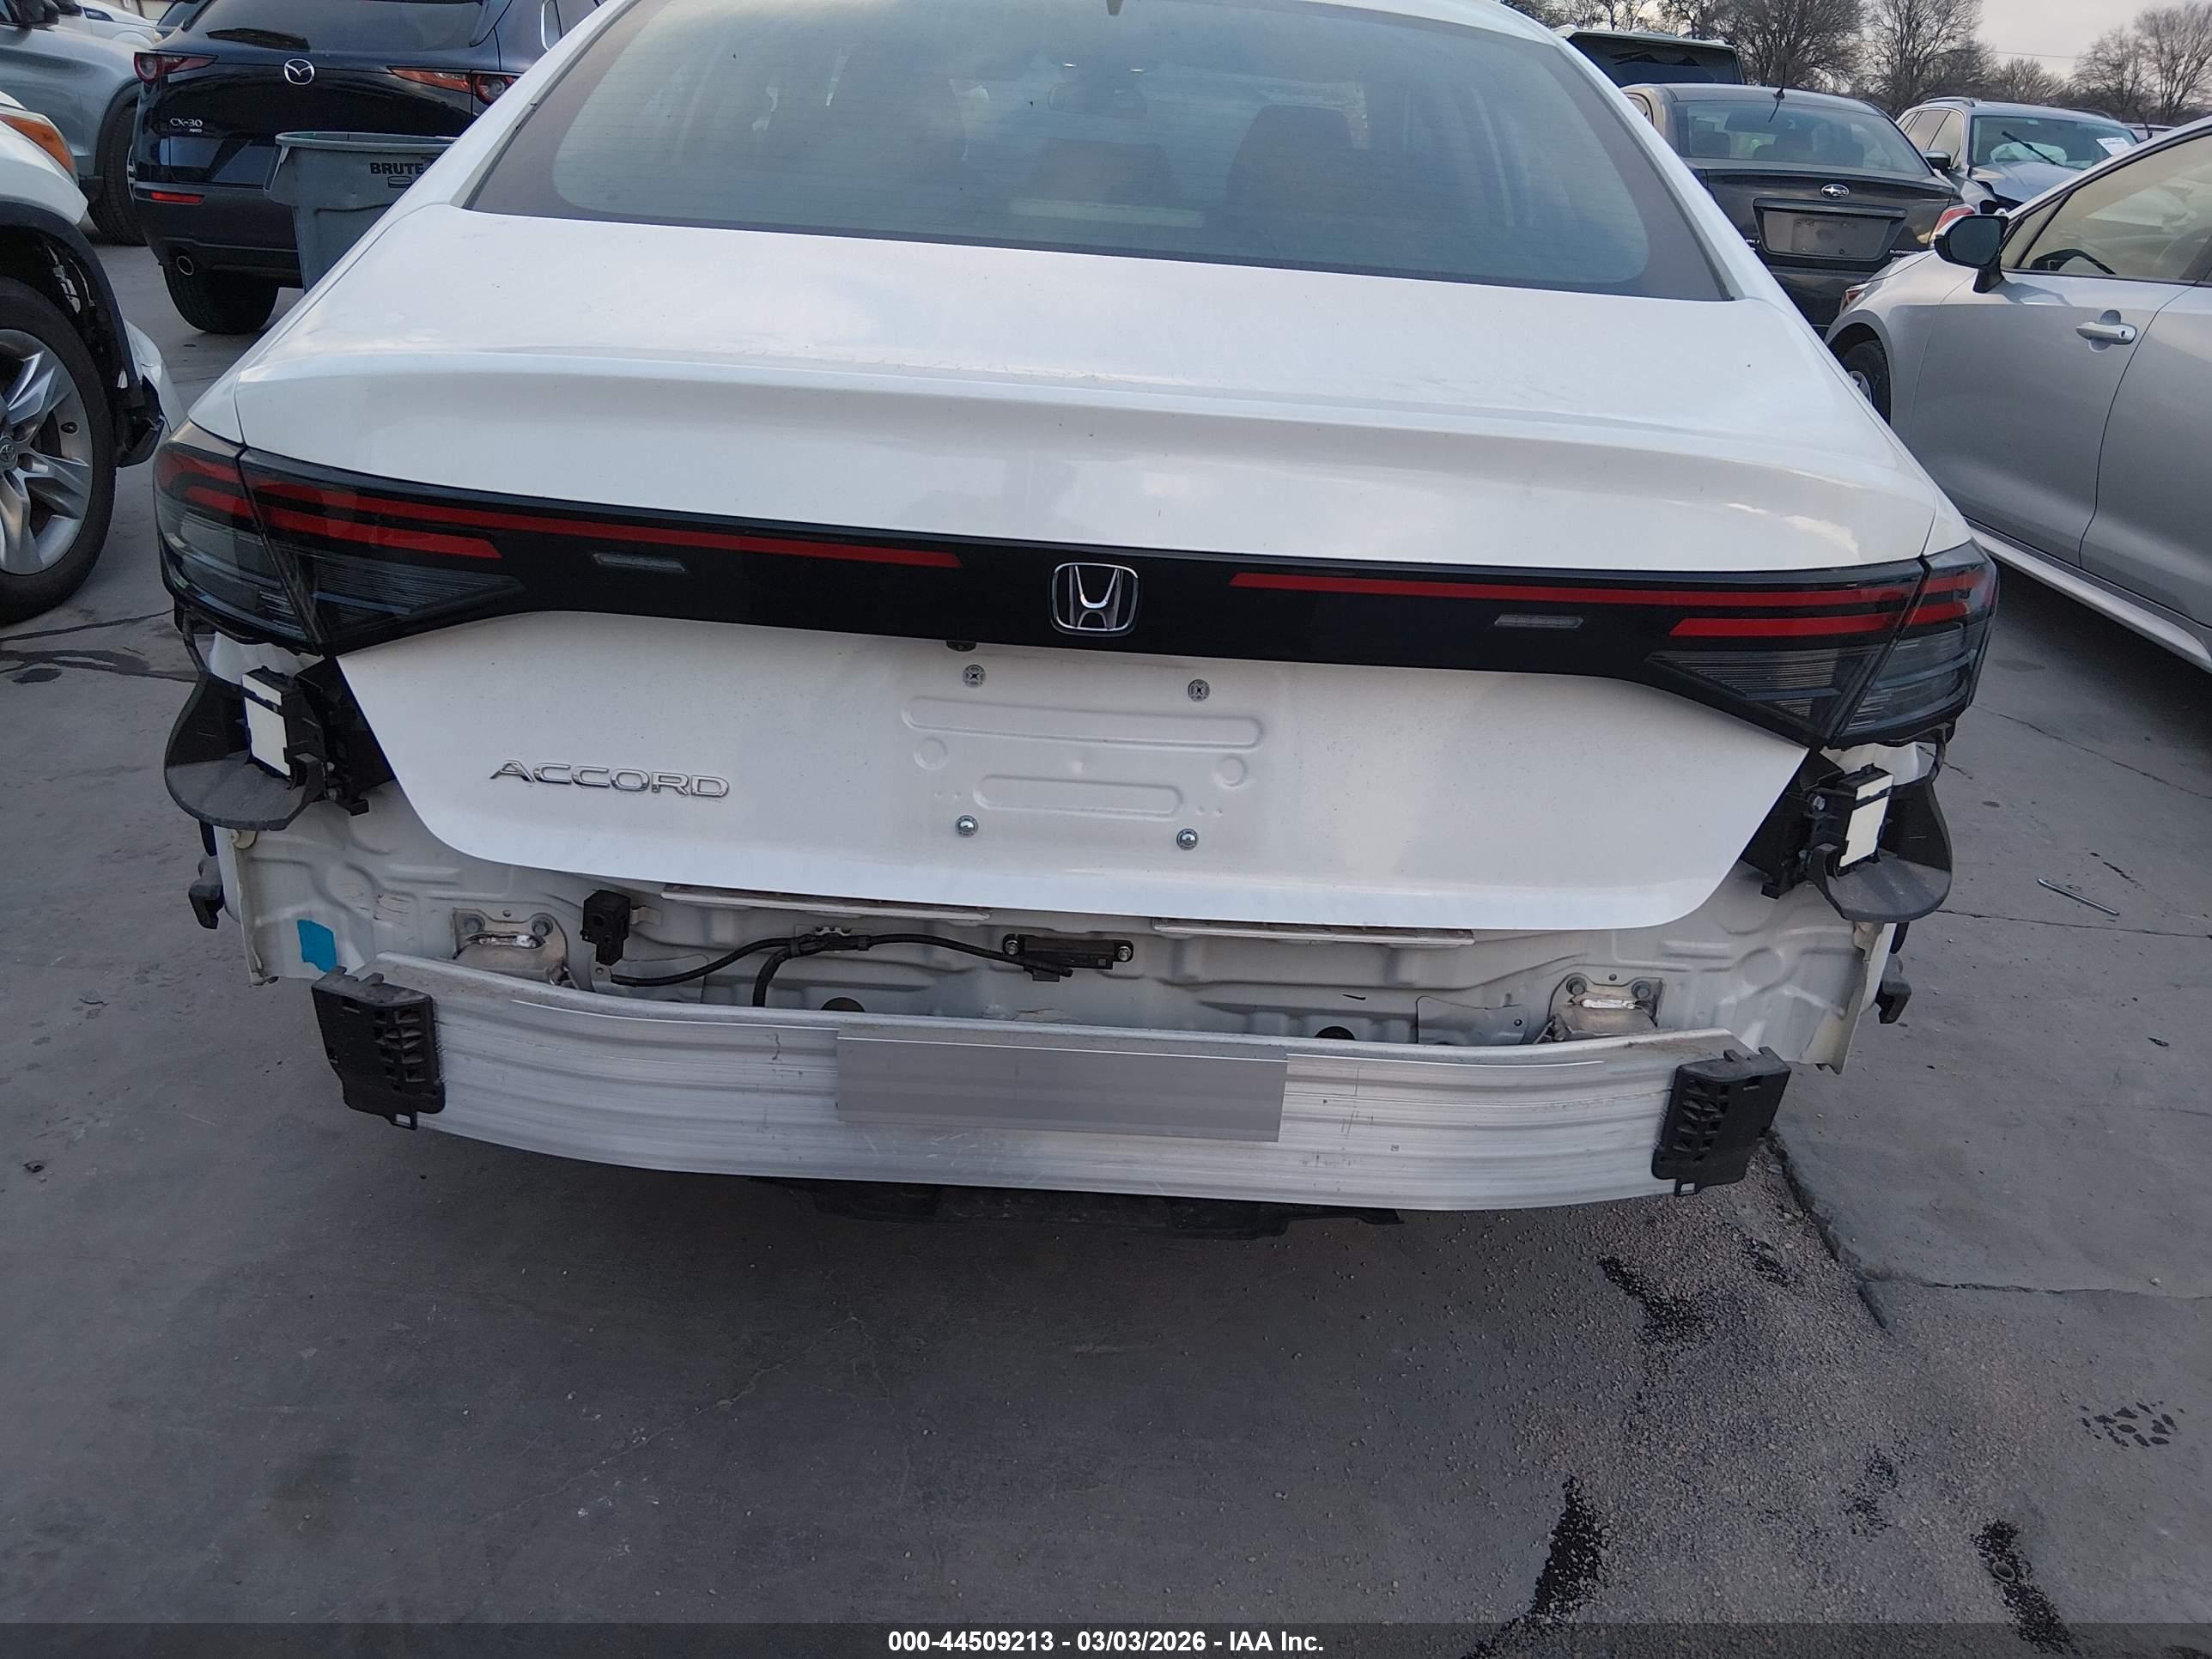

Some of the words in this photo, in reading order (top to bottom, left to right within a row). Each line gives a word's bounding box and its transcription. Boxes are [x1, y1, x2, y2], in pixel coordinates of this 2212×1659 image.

[170, 118, 204, 128] CX-30
[370, 162, 425, 175] BRUTE
[489, 759, 730, 799] ACCORD
